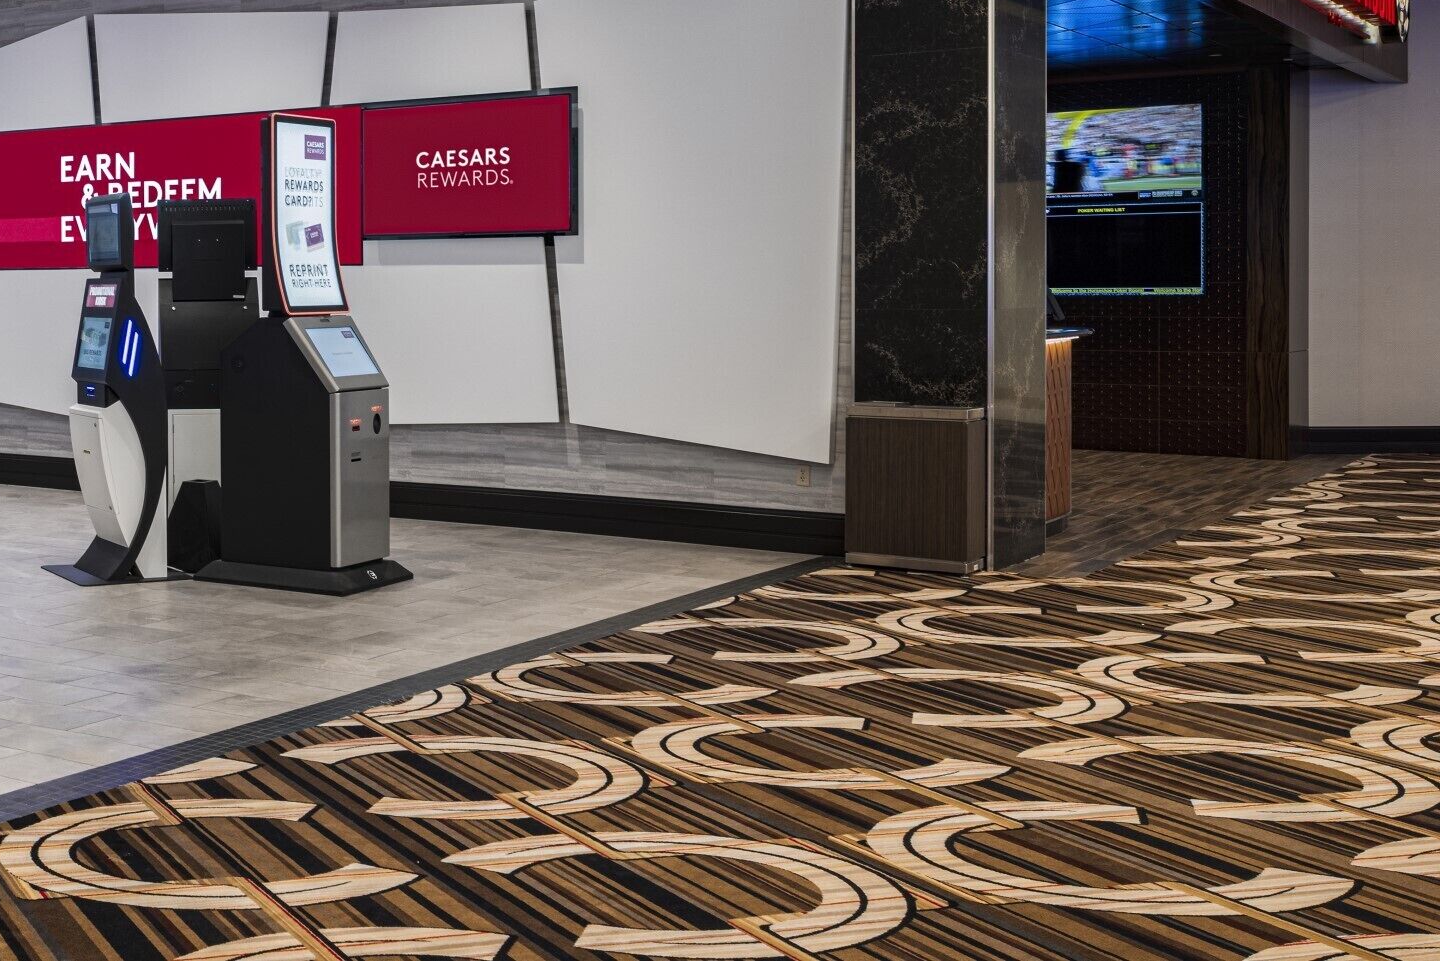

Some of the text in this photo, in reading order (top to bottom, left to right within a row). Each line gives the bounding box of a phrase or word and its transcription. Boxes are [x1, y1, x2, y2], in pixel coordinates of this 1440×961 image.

[306, 140, 325, 148] CAESARS
[416, 146, 511, 169] CAESARS
[60, 151, 135, 183] EARN
[284, 179, 324, 193] REWARDS
[289, 264, 329, 277] REPRINT
